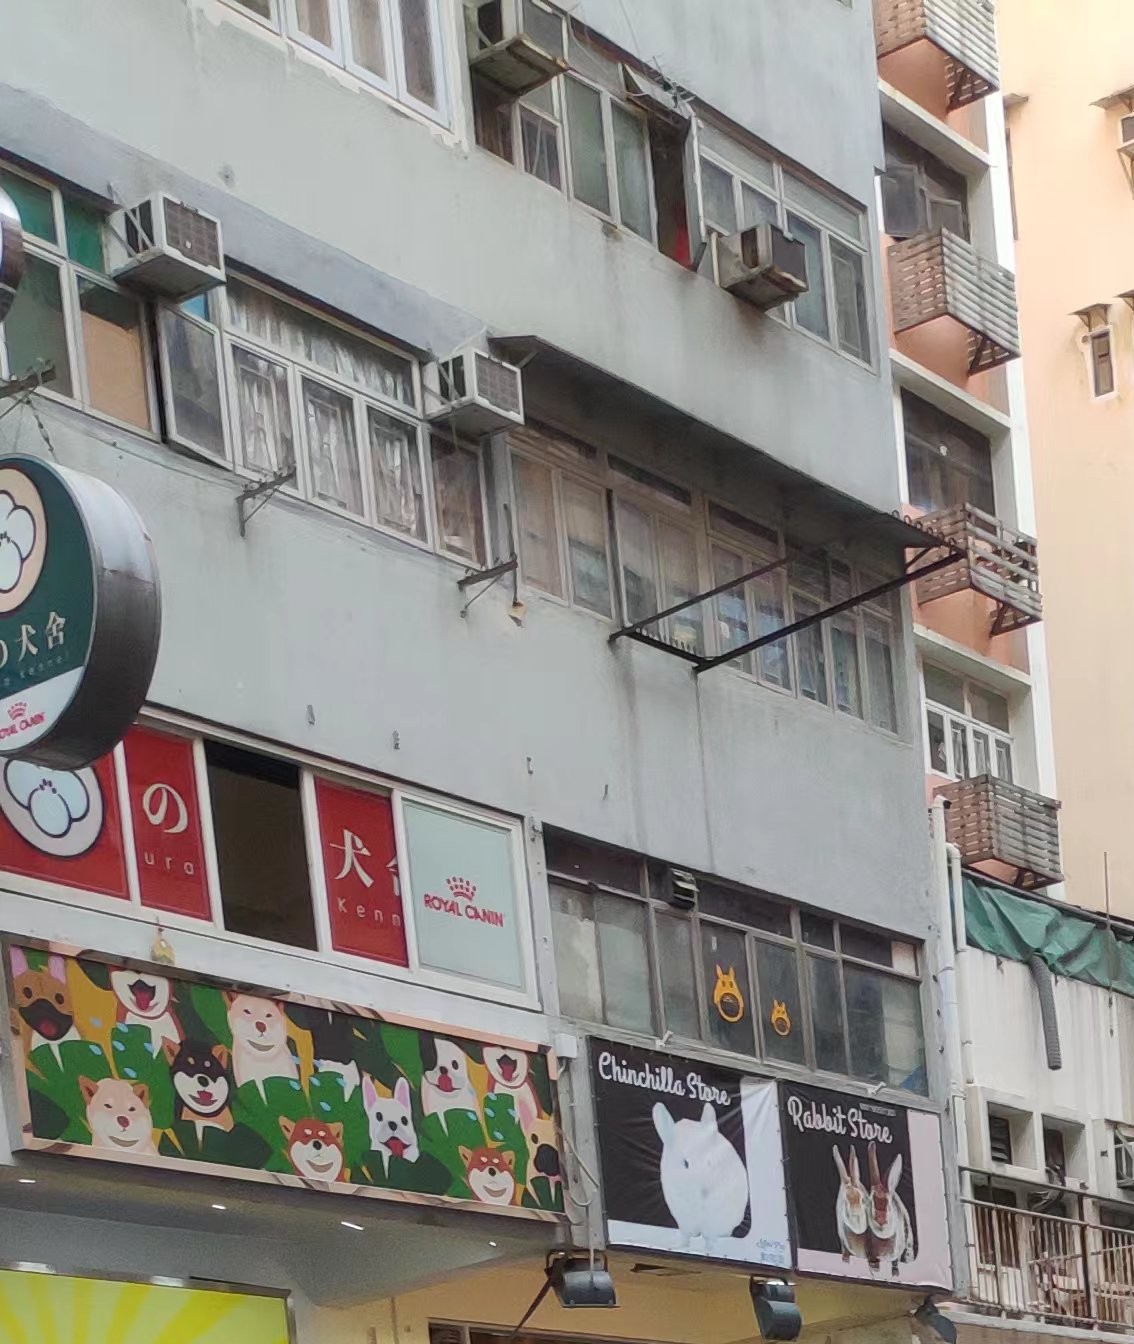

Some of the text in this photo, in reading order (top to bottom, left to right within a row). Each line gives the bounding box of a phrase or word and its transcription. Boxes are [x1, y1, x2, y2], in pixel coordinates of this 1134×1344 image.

[142, 783, 188, 833] の
[424, 893, 505, 929] ROYAL CANIN
[598, 1051, 732, 1106] Chinchilla Store
[787, 1096, 893, 1144] Rabbit Store
